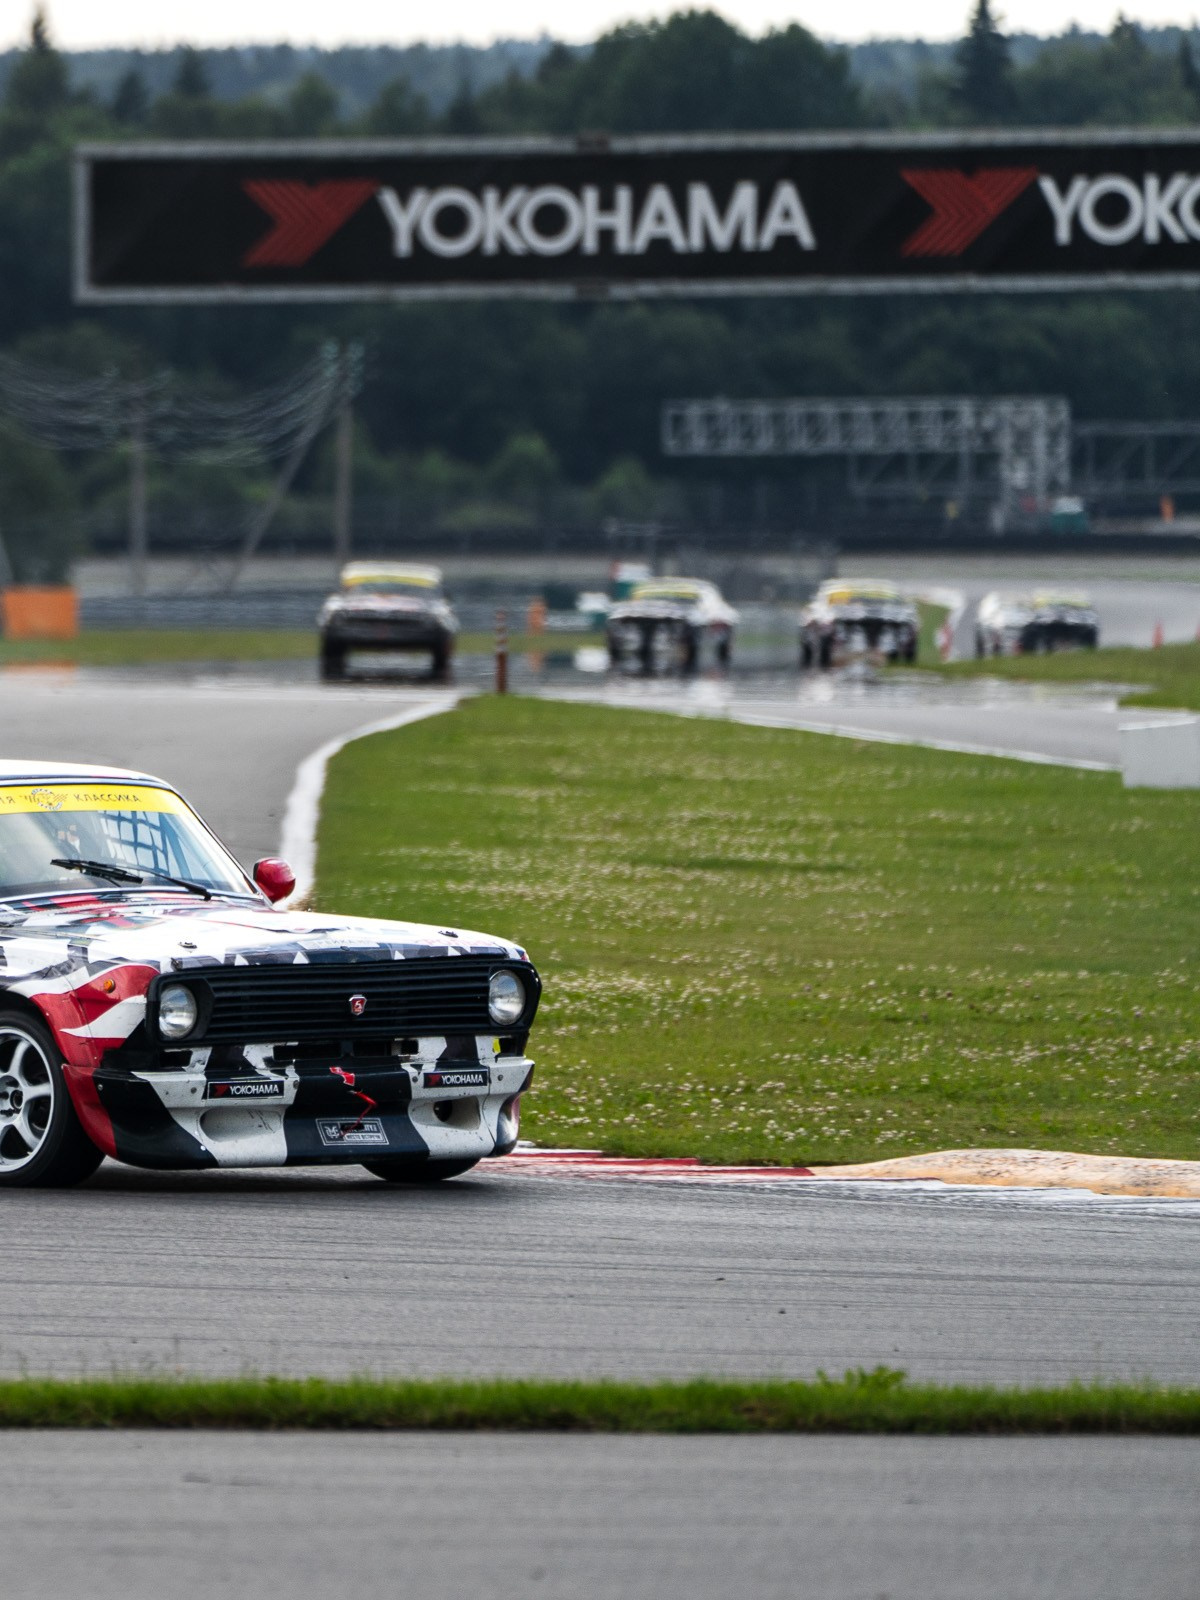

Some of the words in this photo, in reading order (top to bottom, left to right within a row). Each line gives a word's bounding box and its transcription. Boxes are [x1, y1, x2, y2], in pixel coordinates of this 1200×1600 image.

[381, 180, 817, 258] YOKOHAMA
[73, 793, 142, 803] КЛАССИКА
[441, 1074, 484, 1084] YOKOHAMA
[230, 1084, 279, 1095] YOKOHAMA
